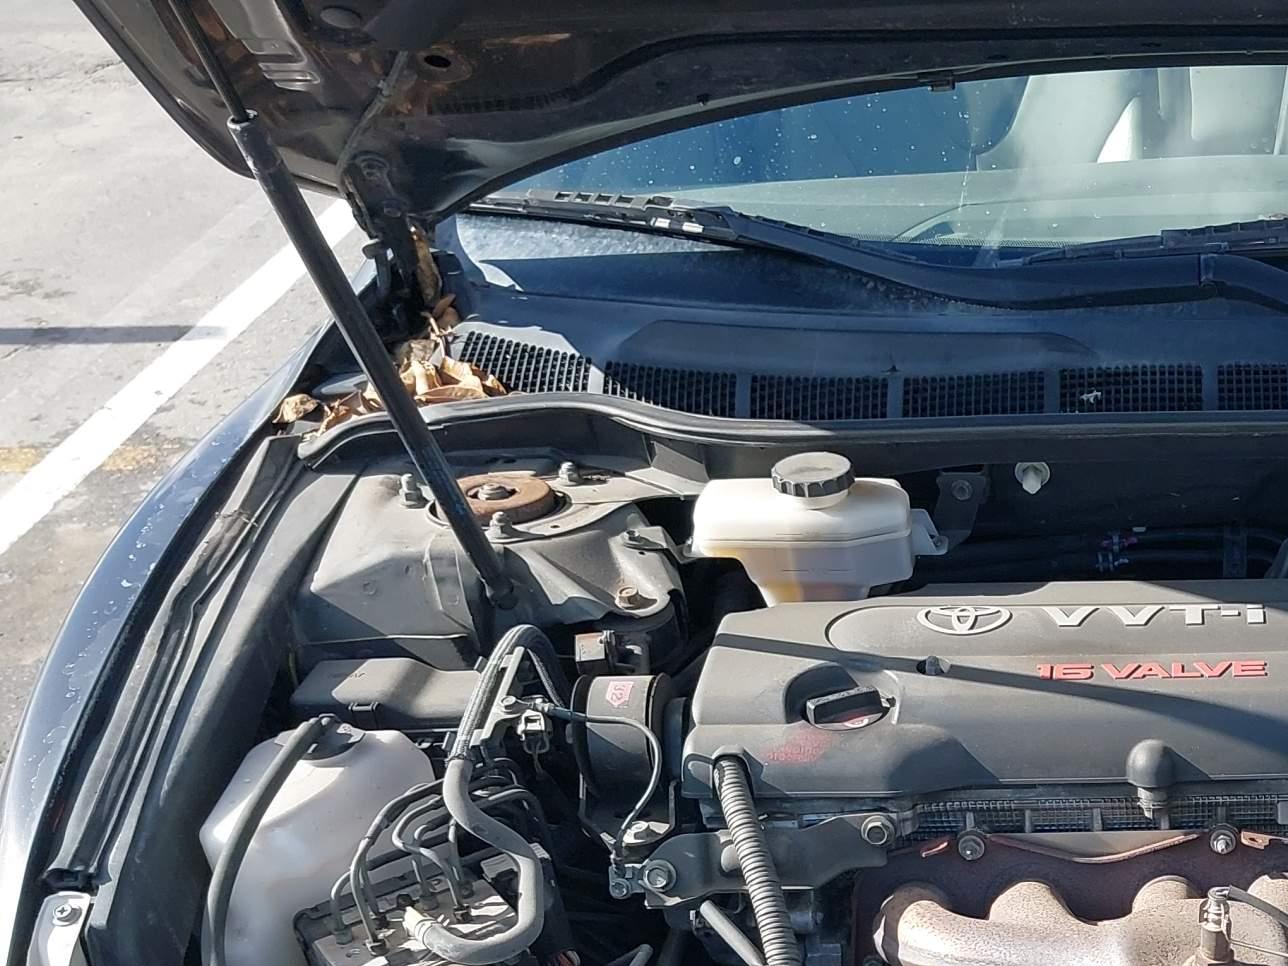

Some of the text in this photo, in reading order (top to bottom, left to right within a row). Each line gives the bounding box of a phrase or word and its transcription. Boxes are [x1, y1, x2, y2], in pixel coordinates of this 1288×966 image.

[1041, 604, 1266, 627] VVT-i
[1037, 661, 1268, 680] 16 VALVE
